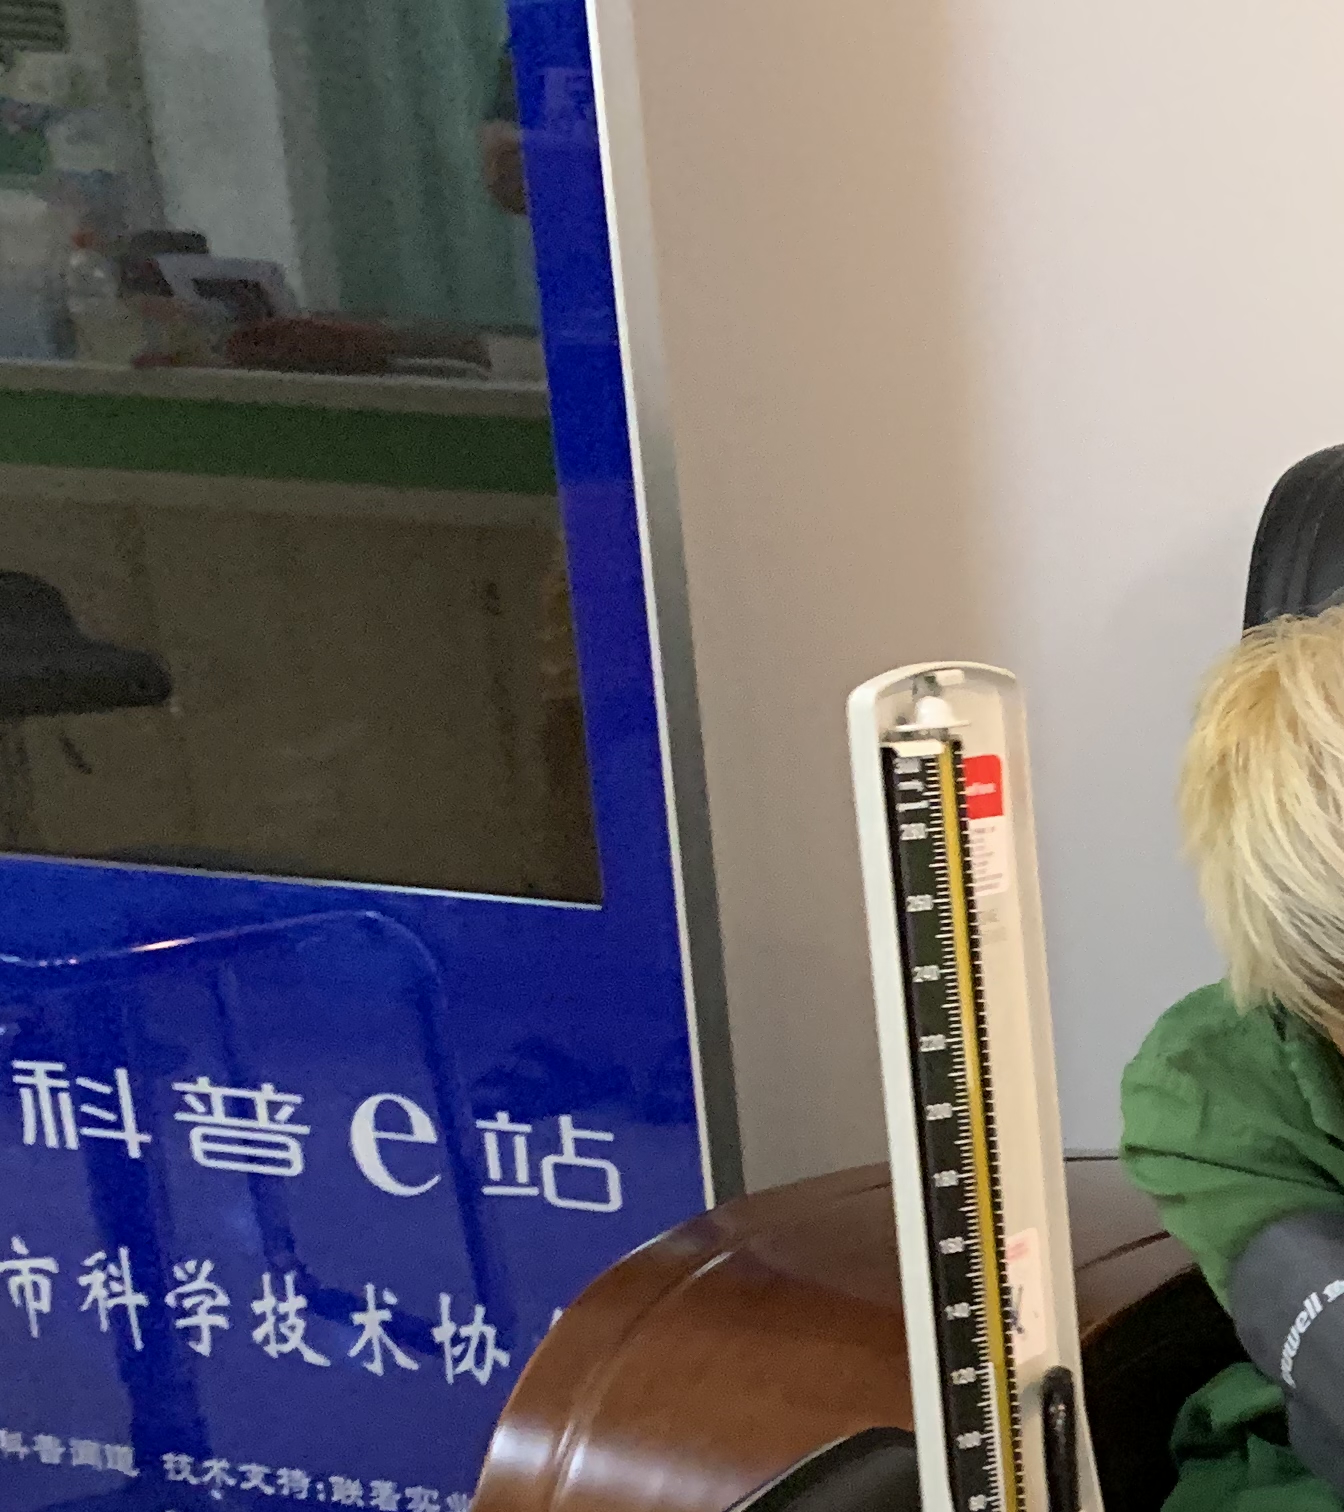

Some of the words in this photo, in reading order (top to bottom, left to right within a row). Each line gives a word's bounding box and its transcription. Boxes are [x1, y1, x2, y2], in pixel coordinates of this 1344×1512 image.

[12, 1058, 624, 1213] 科普e站
[0, 1236, 564, 1386] 市科学技术协
